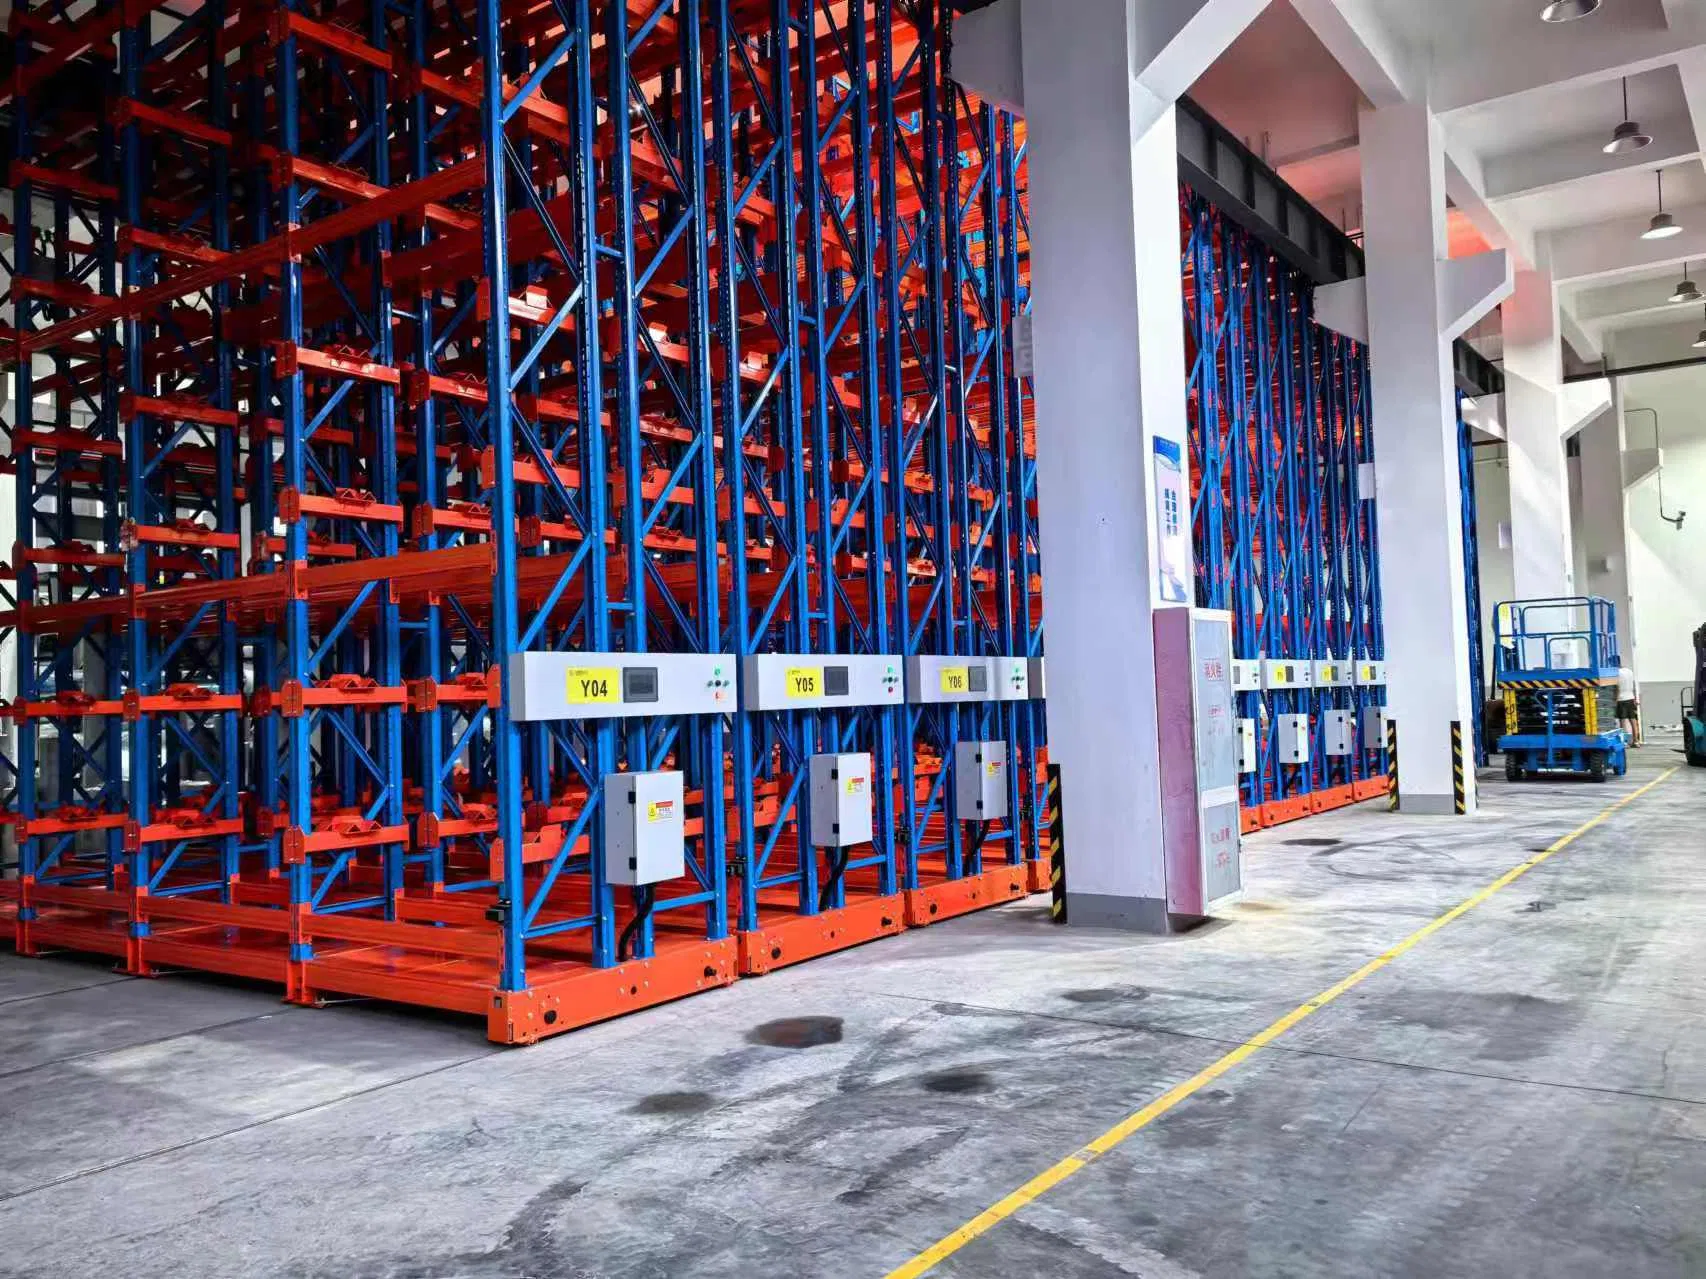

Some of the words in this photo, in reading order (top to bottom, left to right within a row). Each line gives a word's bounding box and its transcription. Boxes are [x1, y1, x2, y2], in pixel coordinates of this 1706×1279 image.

[581, 680, 608, 697] Y04
[795, 677, 814, 693] Y05
[948, 675, 962, 689] Y06
